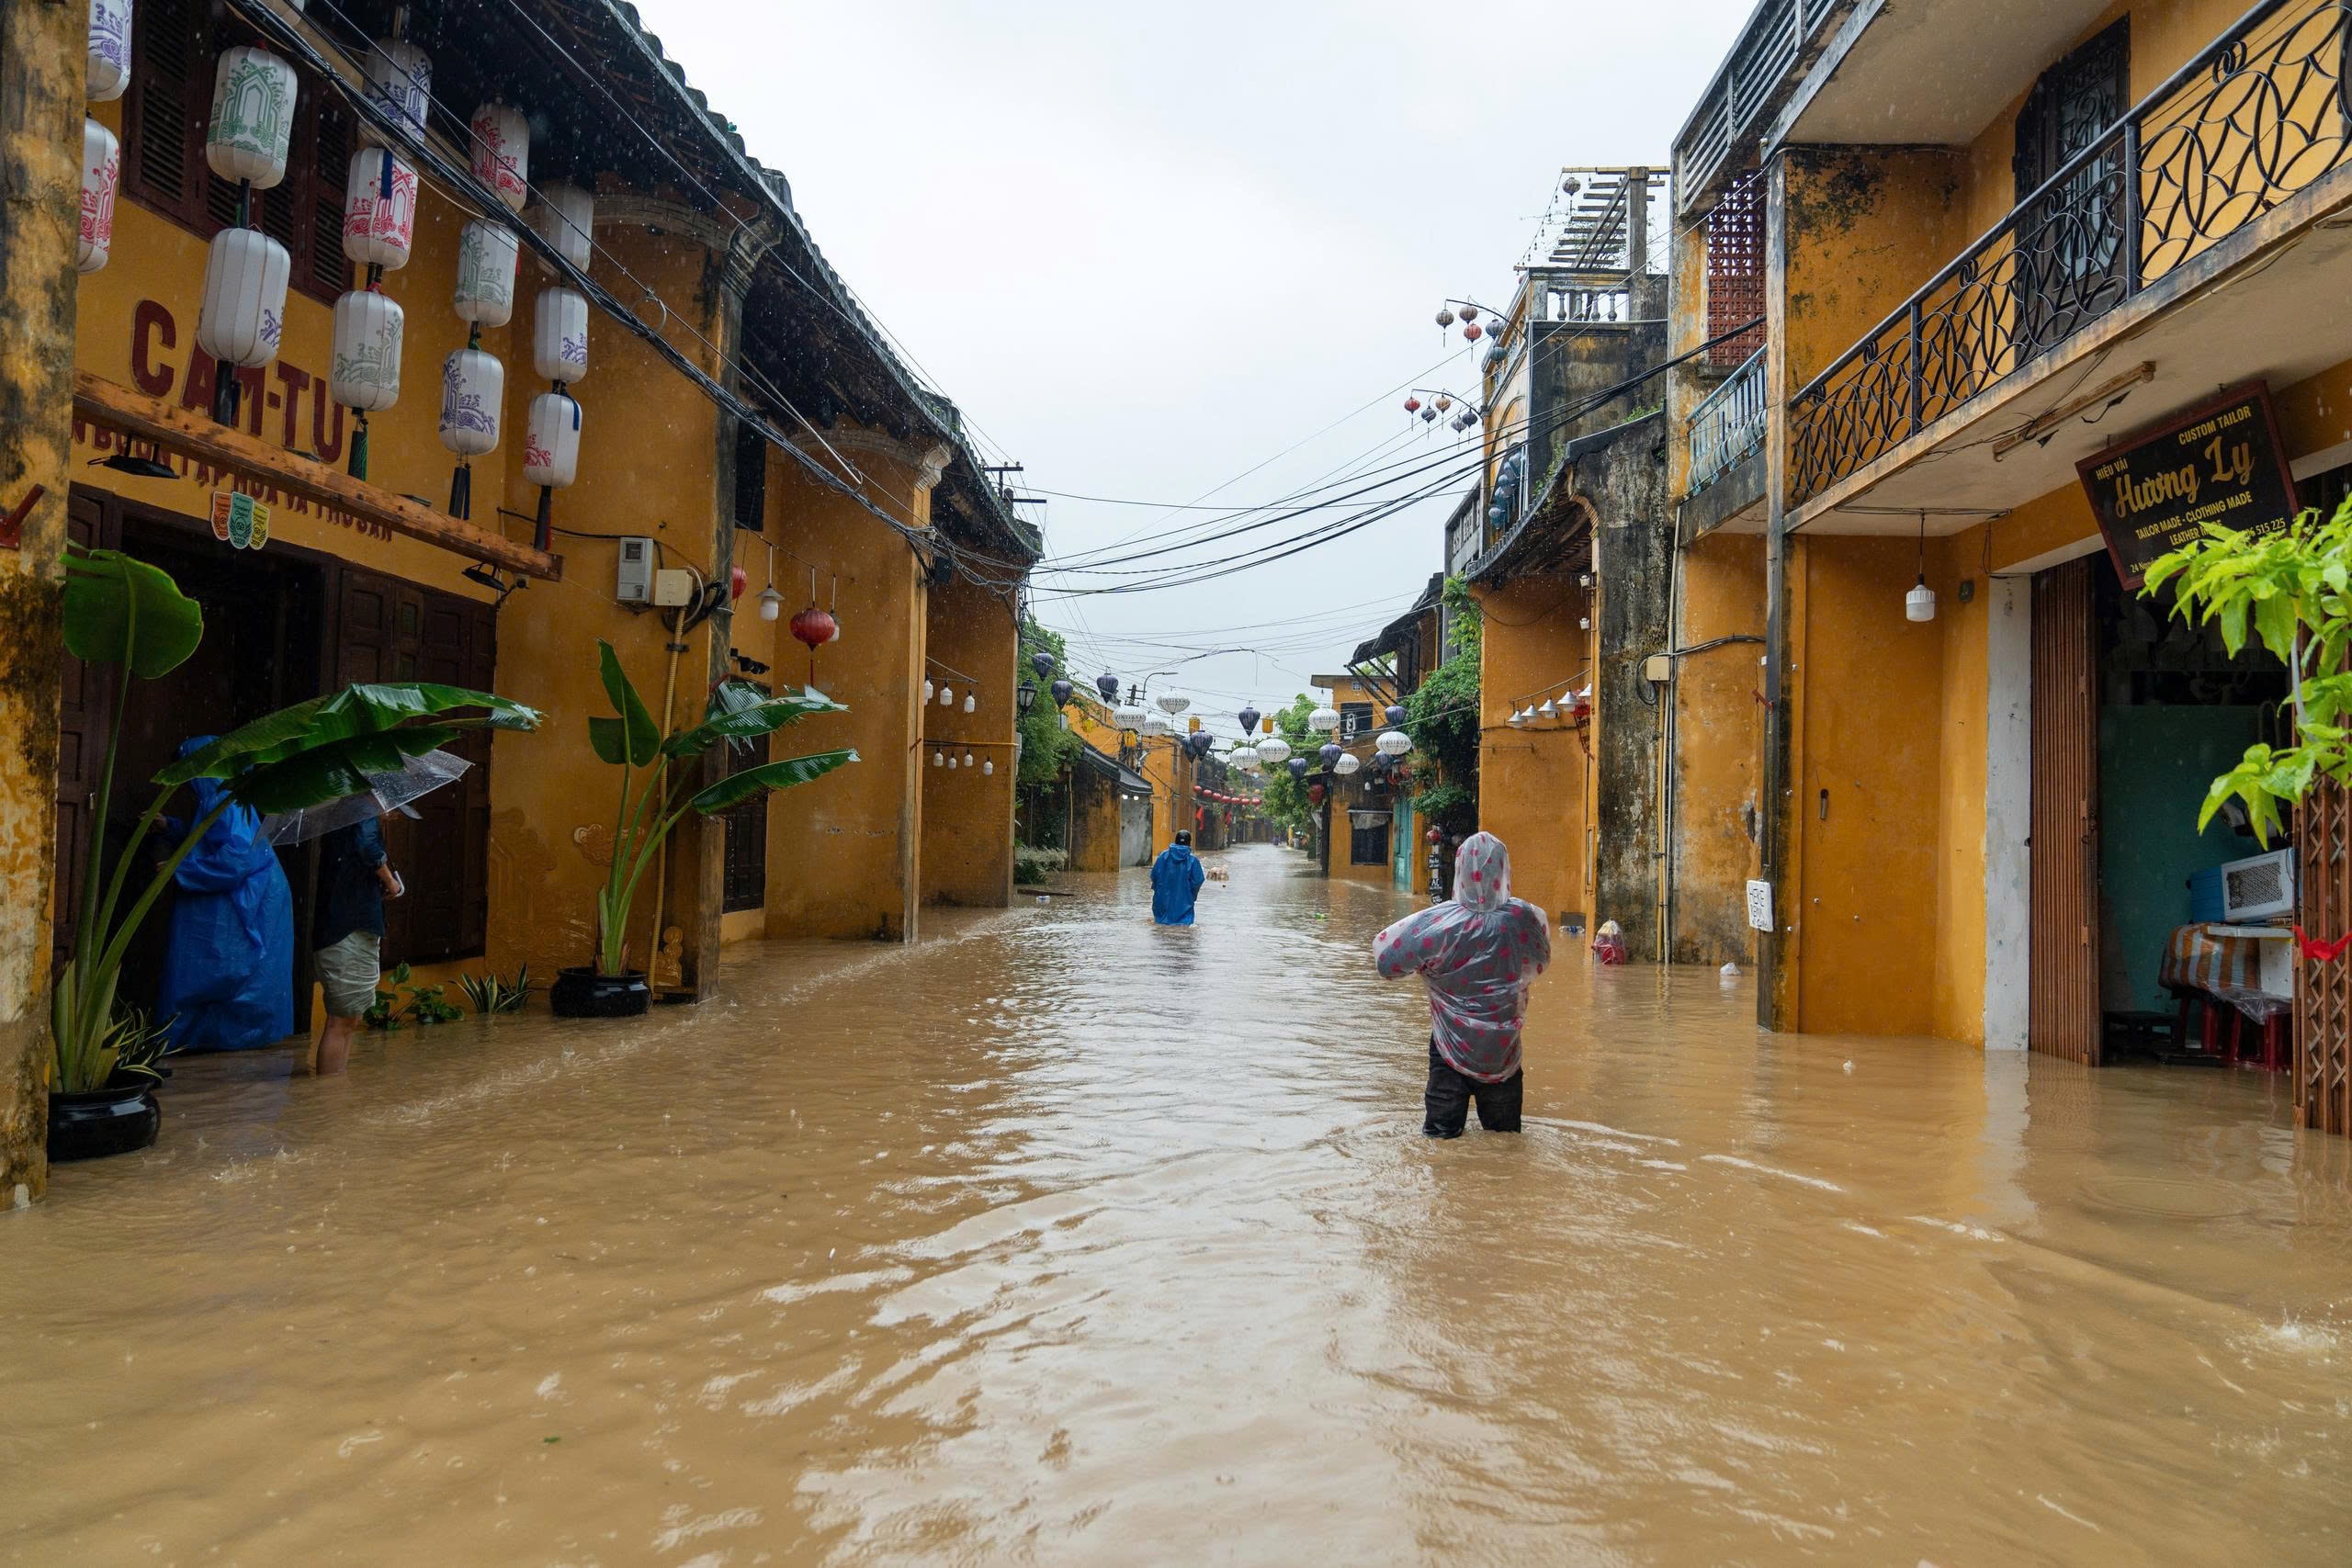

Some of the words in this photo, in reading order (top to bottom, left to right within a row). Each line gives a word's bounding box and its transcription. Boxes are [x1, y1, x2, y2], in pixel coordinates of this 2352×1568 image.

[2178, 420, 2217, 446] CUSTOM
[2218, 405, 2251, 429] TAILOR
[2115, 463, 2200, 518] Hương
[2205, 435, 2256, 486] Ly
[2135, 523, 2160, 540] TAILOR
[2160, 515, 2183, 533] MADE
[2186, 501, 2226, 524] CLOTHING
[2226, 491, 2252, 510] MADE
[2256, 523, 2270, 536] 515
[2270, 517, 2286, 531] 225
[2169, 528, 2200, 547] LEATHER
